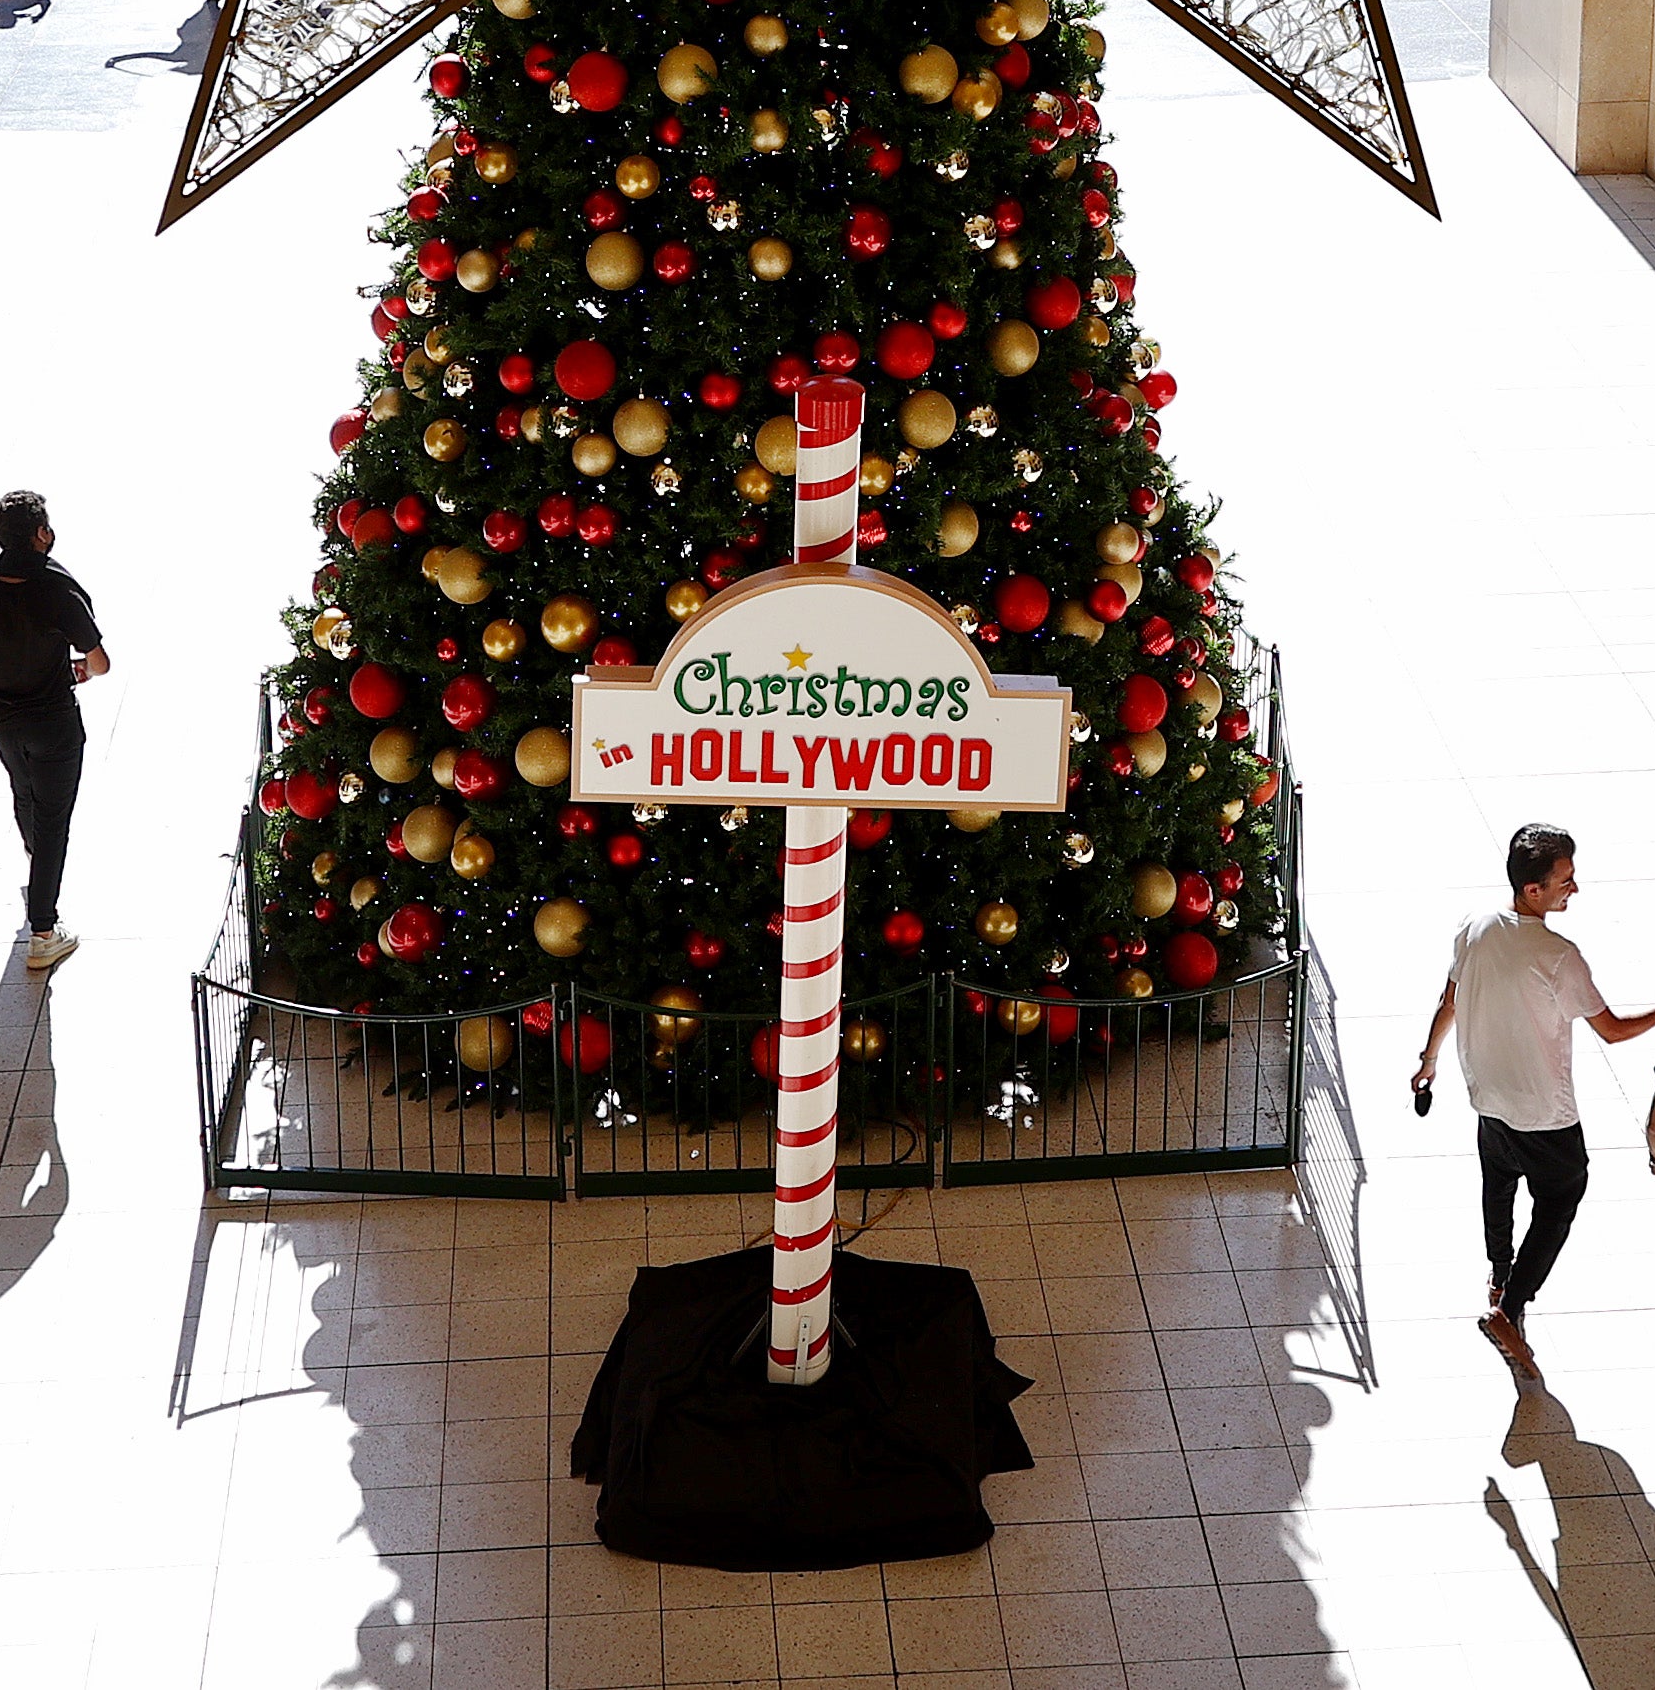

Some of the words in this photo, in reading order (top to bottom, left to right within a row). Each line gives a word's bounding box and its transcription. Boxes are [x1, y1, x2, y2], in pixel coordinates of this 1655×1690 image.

[674, 652, 971, 721] Christmas
[598, 742, 634, 768] in
[651, 728, 992, 792] HOLLYWOOD
